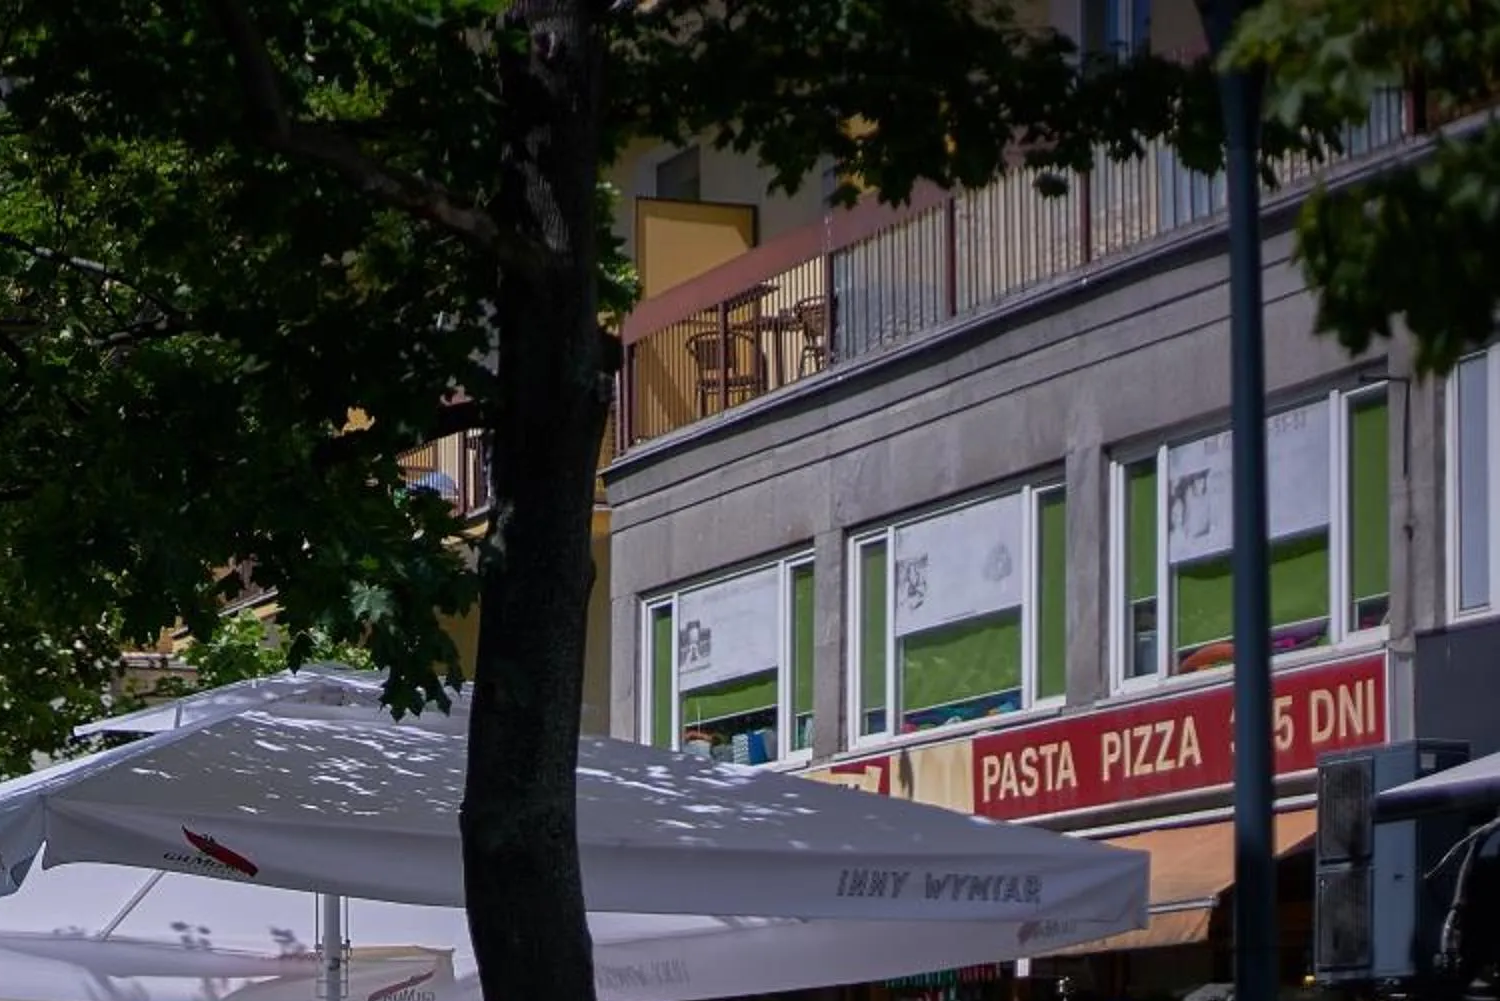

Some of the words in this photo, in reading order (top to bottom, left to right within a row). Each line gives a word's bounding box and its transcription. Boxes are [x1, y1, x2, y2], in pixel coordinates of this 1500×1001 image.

[982, 740, 1077, 803] PASTA
[1100, 715, 1202, 782] PIZZA
[1311, 679, 1377, 744] DNI
[836, 869, 912, 899] INNY
[924, 873, 1042, 904] WYMIAR
